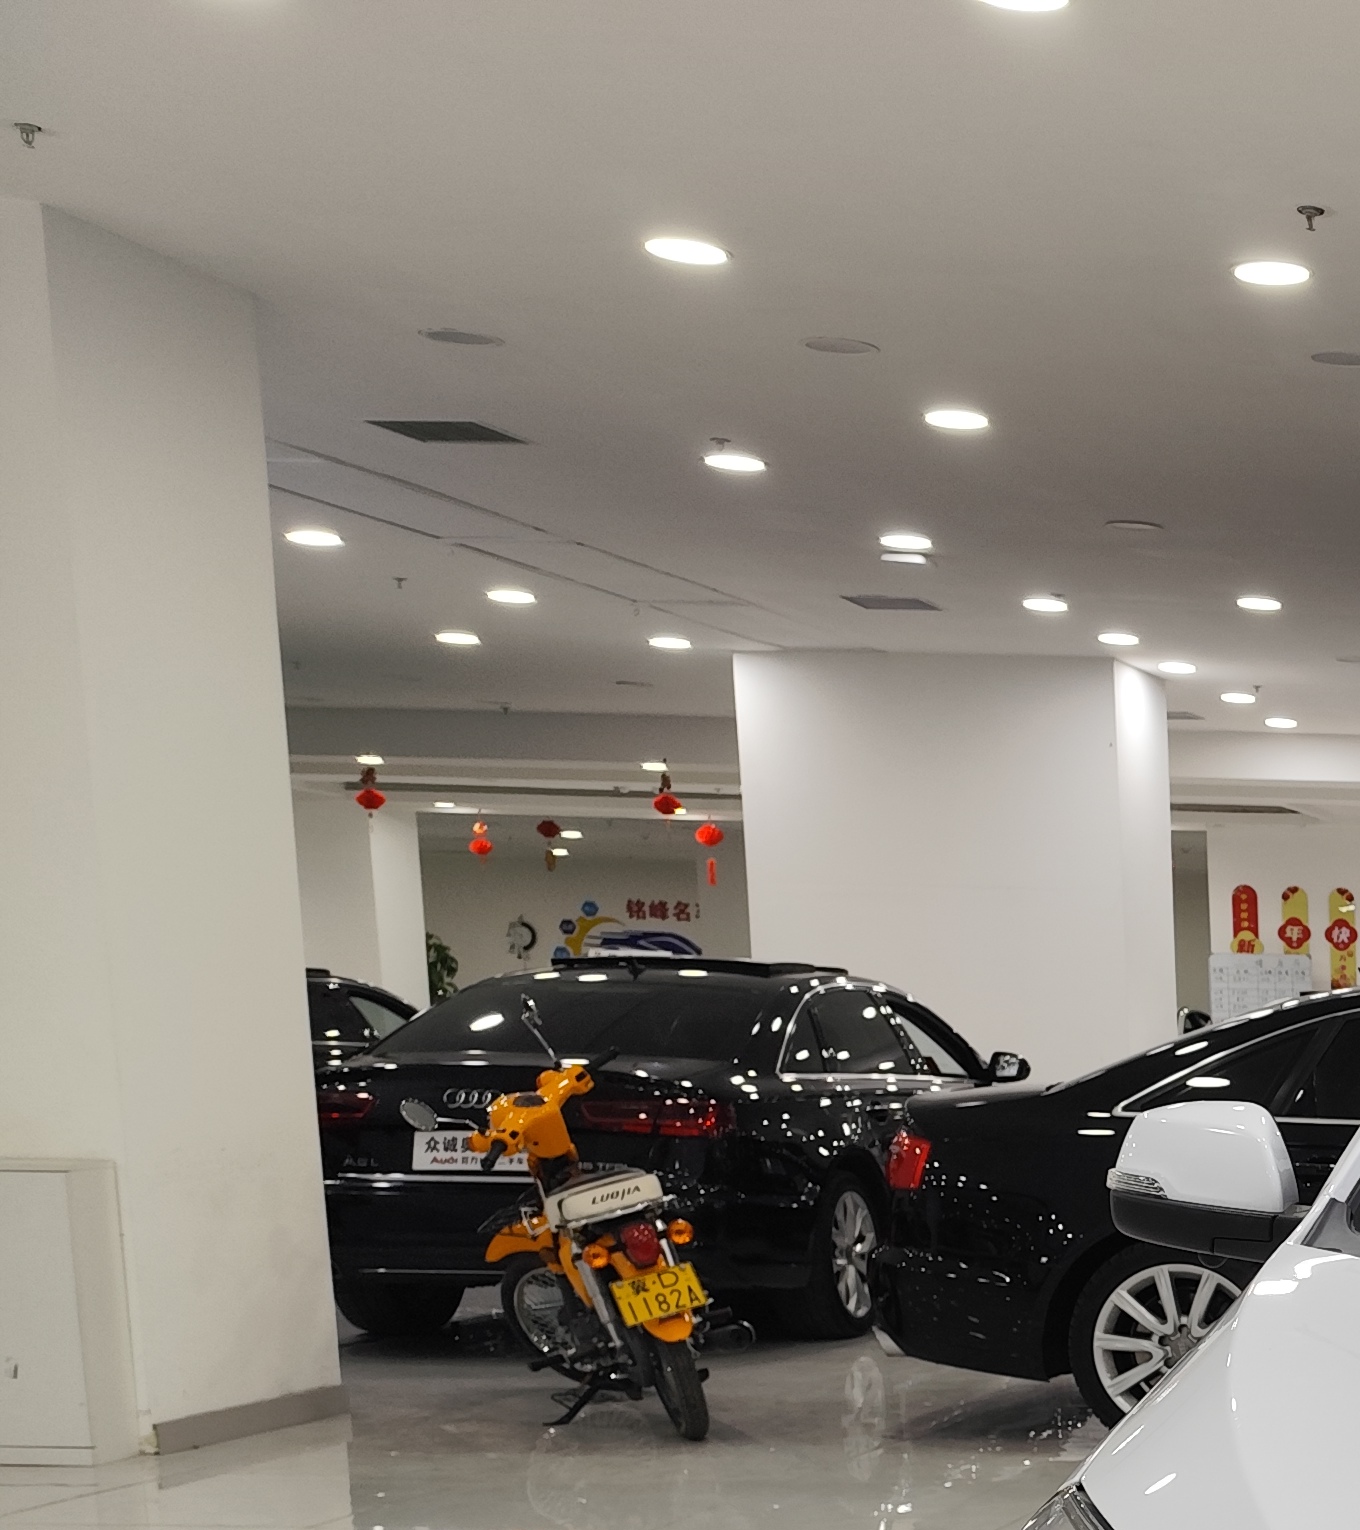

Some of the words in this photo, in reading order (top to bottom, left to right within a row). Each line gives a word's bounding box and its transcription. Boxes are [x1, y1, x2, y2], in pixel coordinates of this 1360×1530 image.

[626, 898, 701, 922] 铭峰名
[591, 1185, 641, 1206] LUOJIA
[627, 1285, 702, 1322] 1182A
